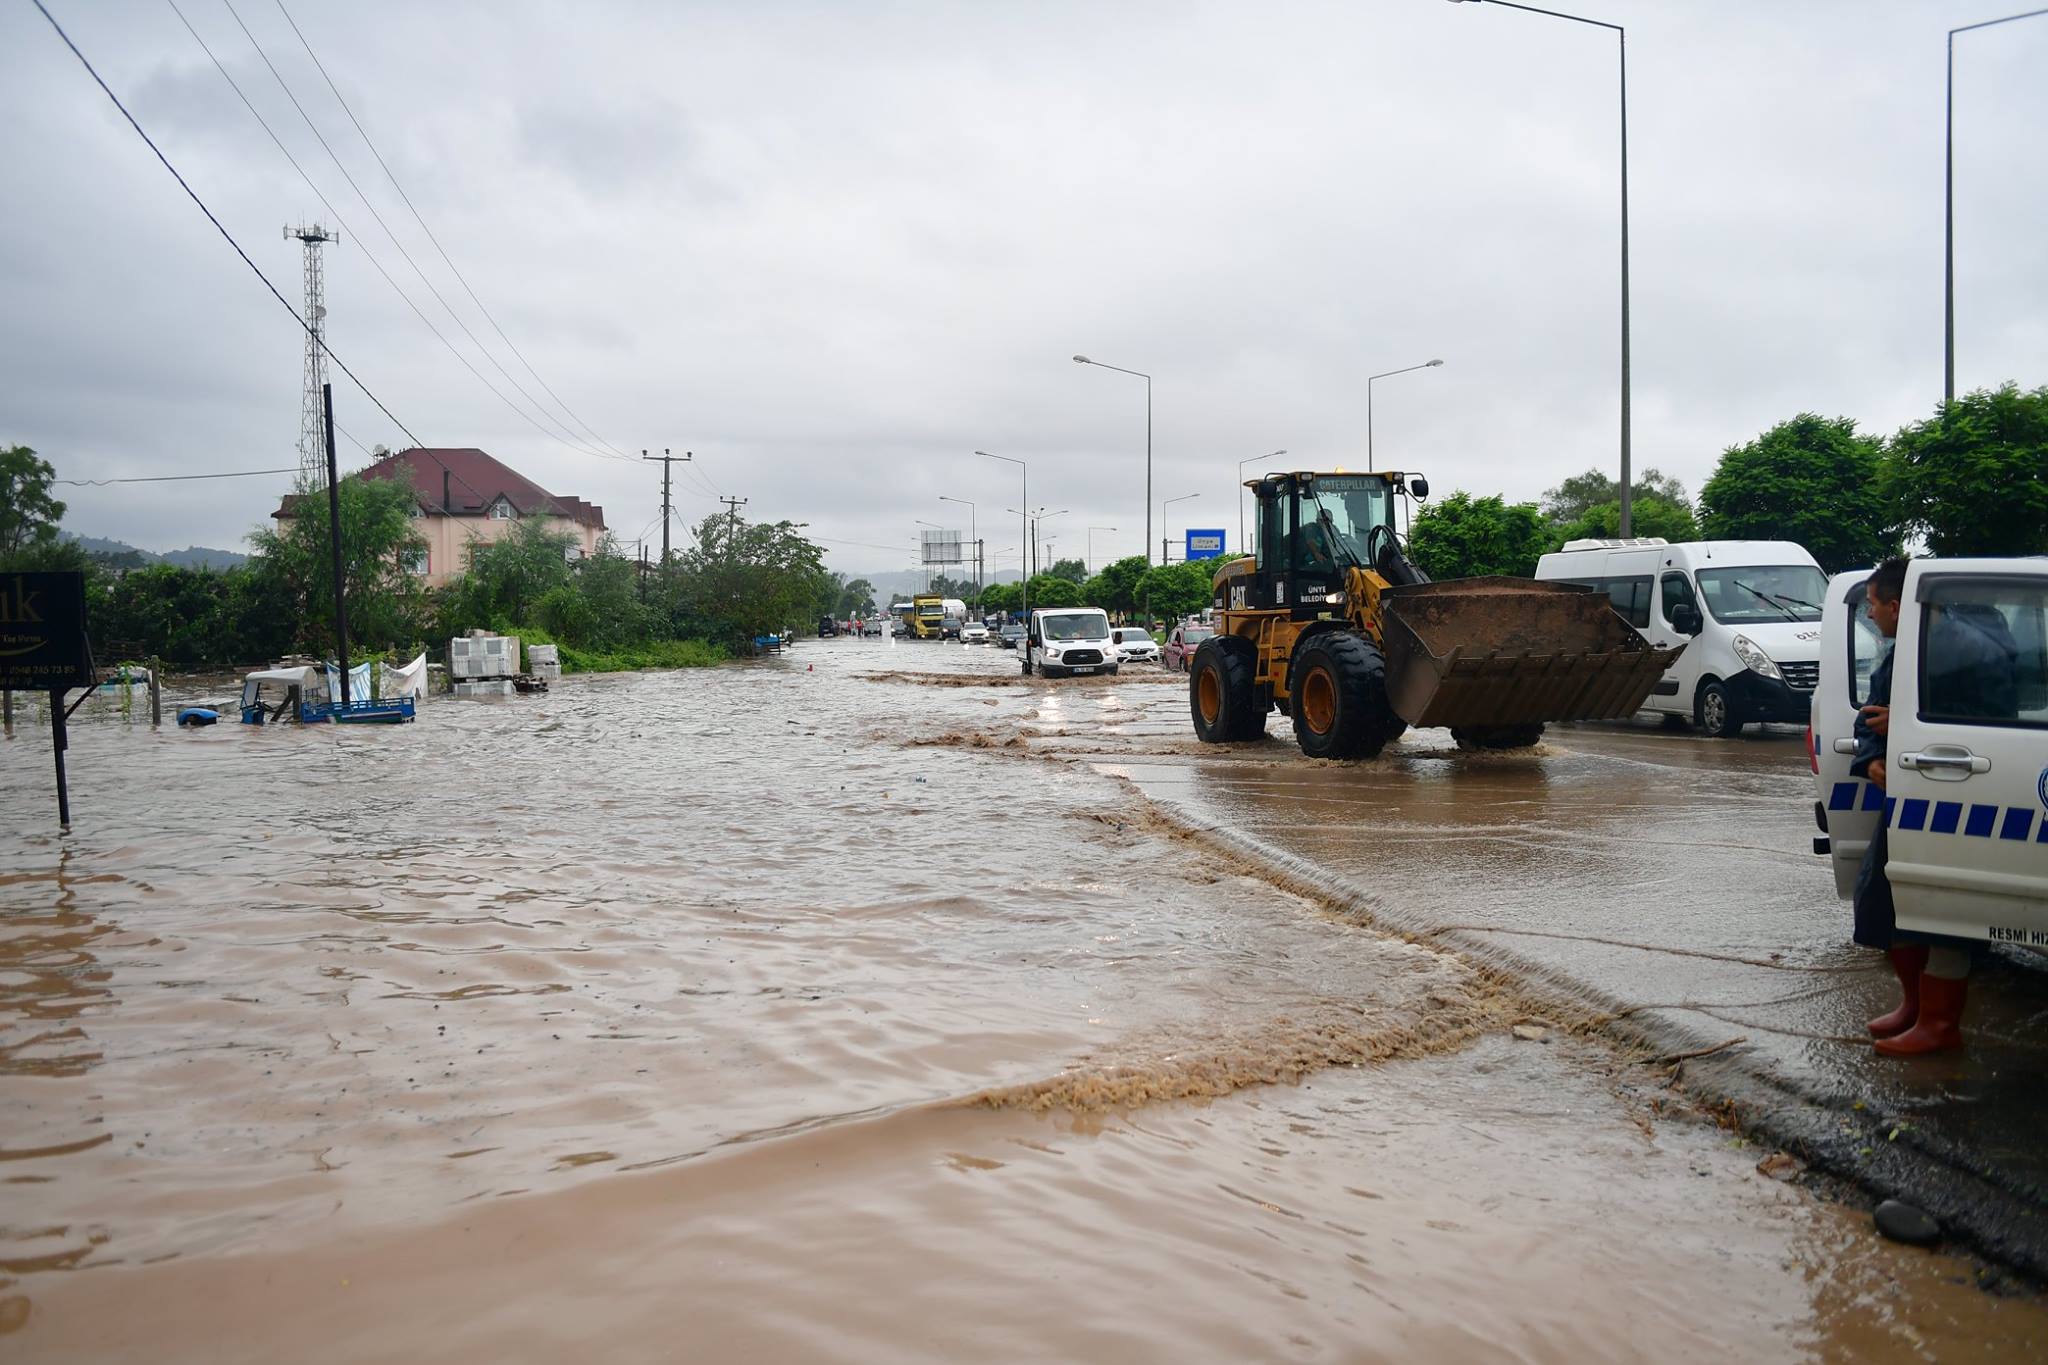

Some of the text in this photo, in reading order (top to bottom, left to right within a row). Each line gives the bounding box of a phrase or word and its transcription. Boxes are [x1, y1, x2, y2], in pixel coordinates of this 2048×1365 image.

[1320, 479, 1376, 490] CATERPILLAR
[1308, 584, 1326, 594] ÜNYE
[1231, 585, 1246, 611] CAT
[1989, 926, 2027, 943] RESMİ
